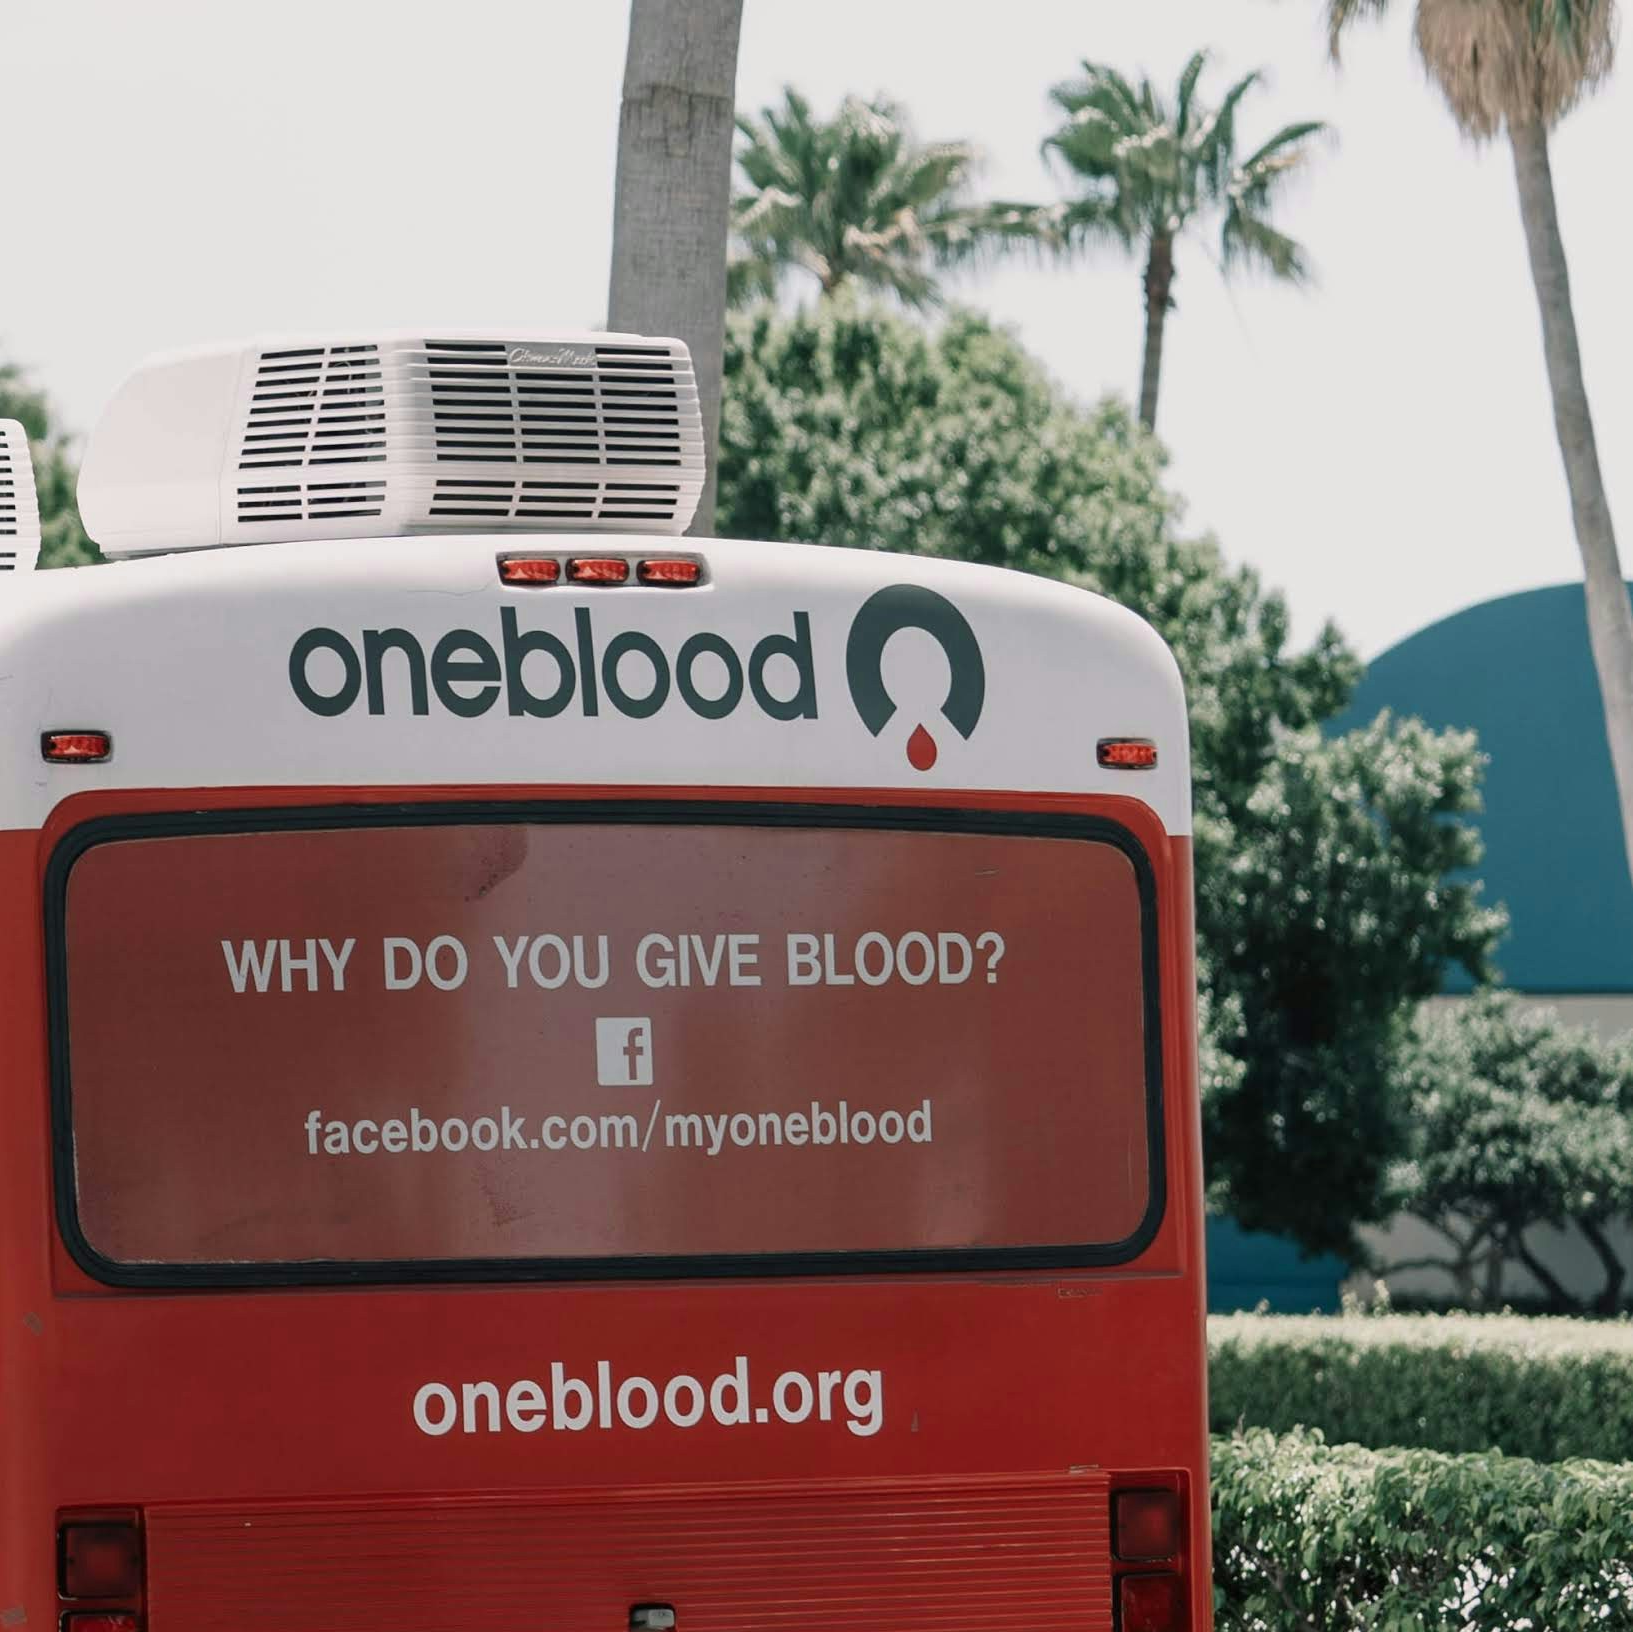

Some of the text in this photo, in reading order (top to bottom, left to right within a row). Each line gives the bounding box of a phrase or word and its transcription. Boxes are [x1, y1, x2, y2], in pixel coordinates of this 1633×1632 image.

[288, 606, 819, 721] oneblood
[219, 930, 1006, 993] WHY DO YOU GIVE BLOOD?
[304, 1099, 934, 1156] facebook.com/myoneblood
[413, 1355, 884, 1437] oneblood.org
